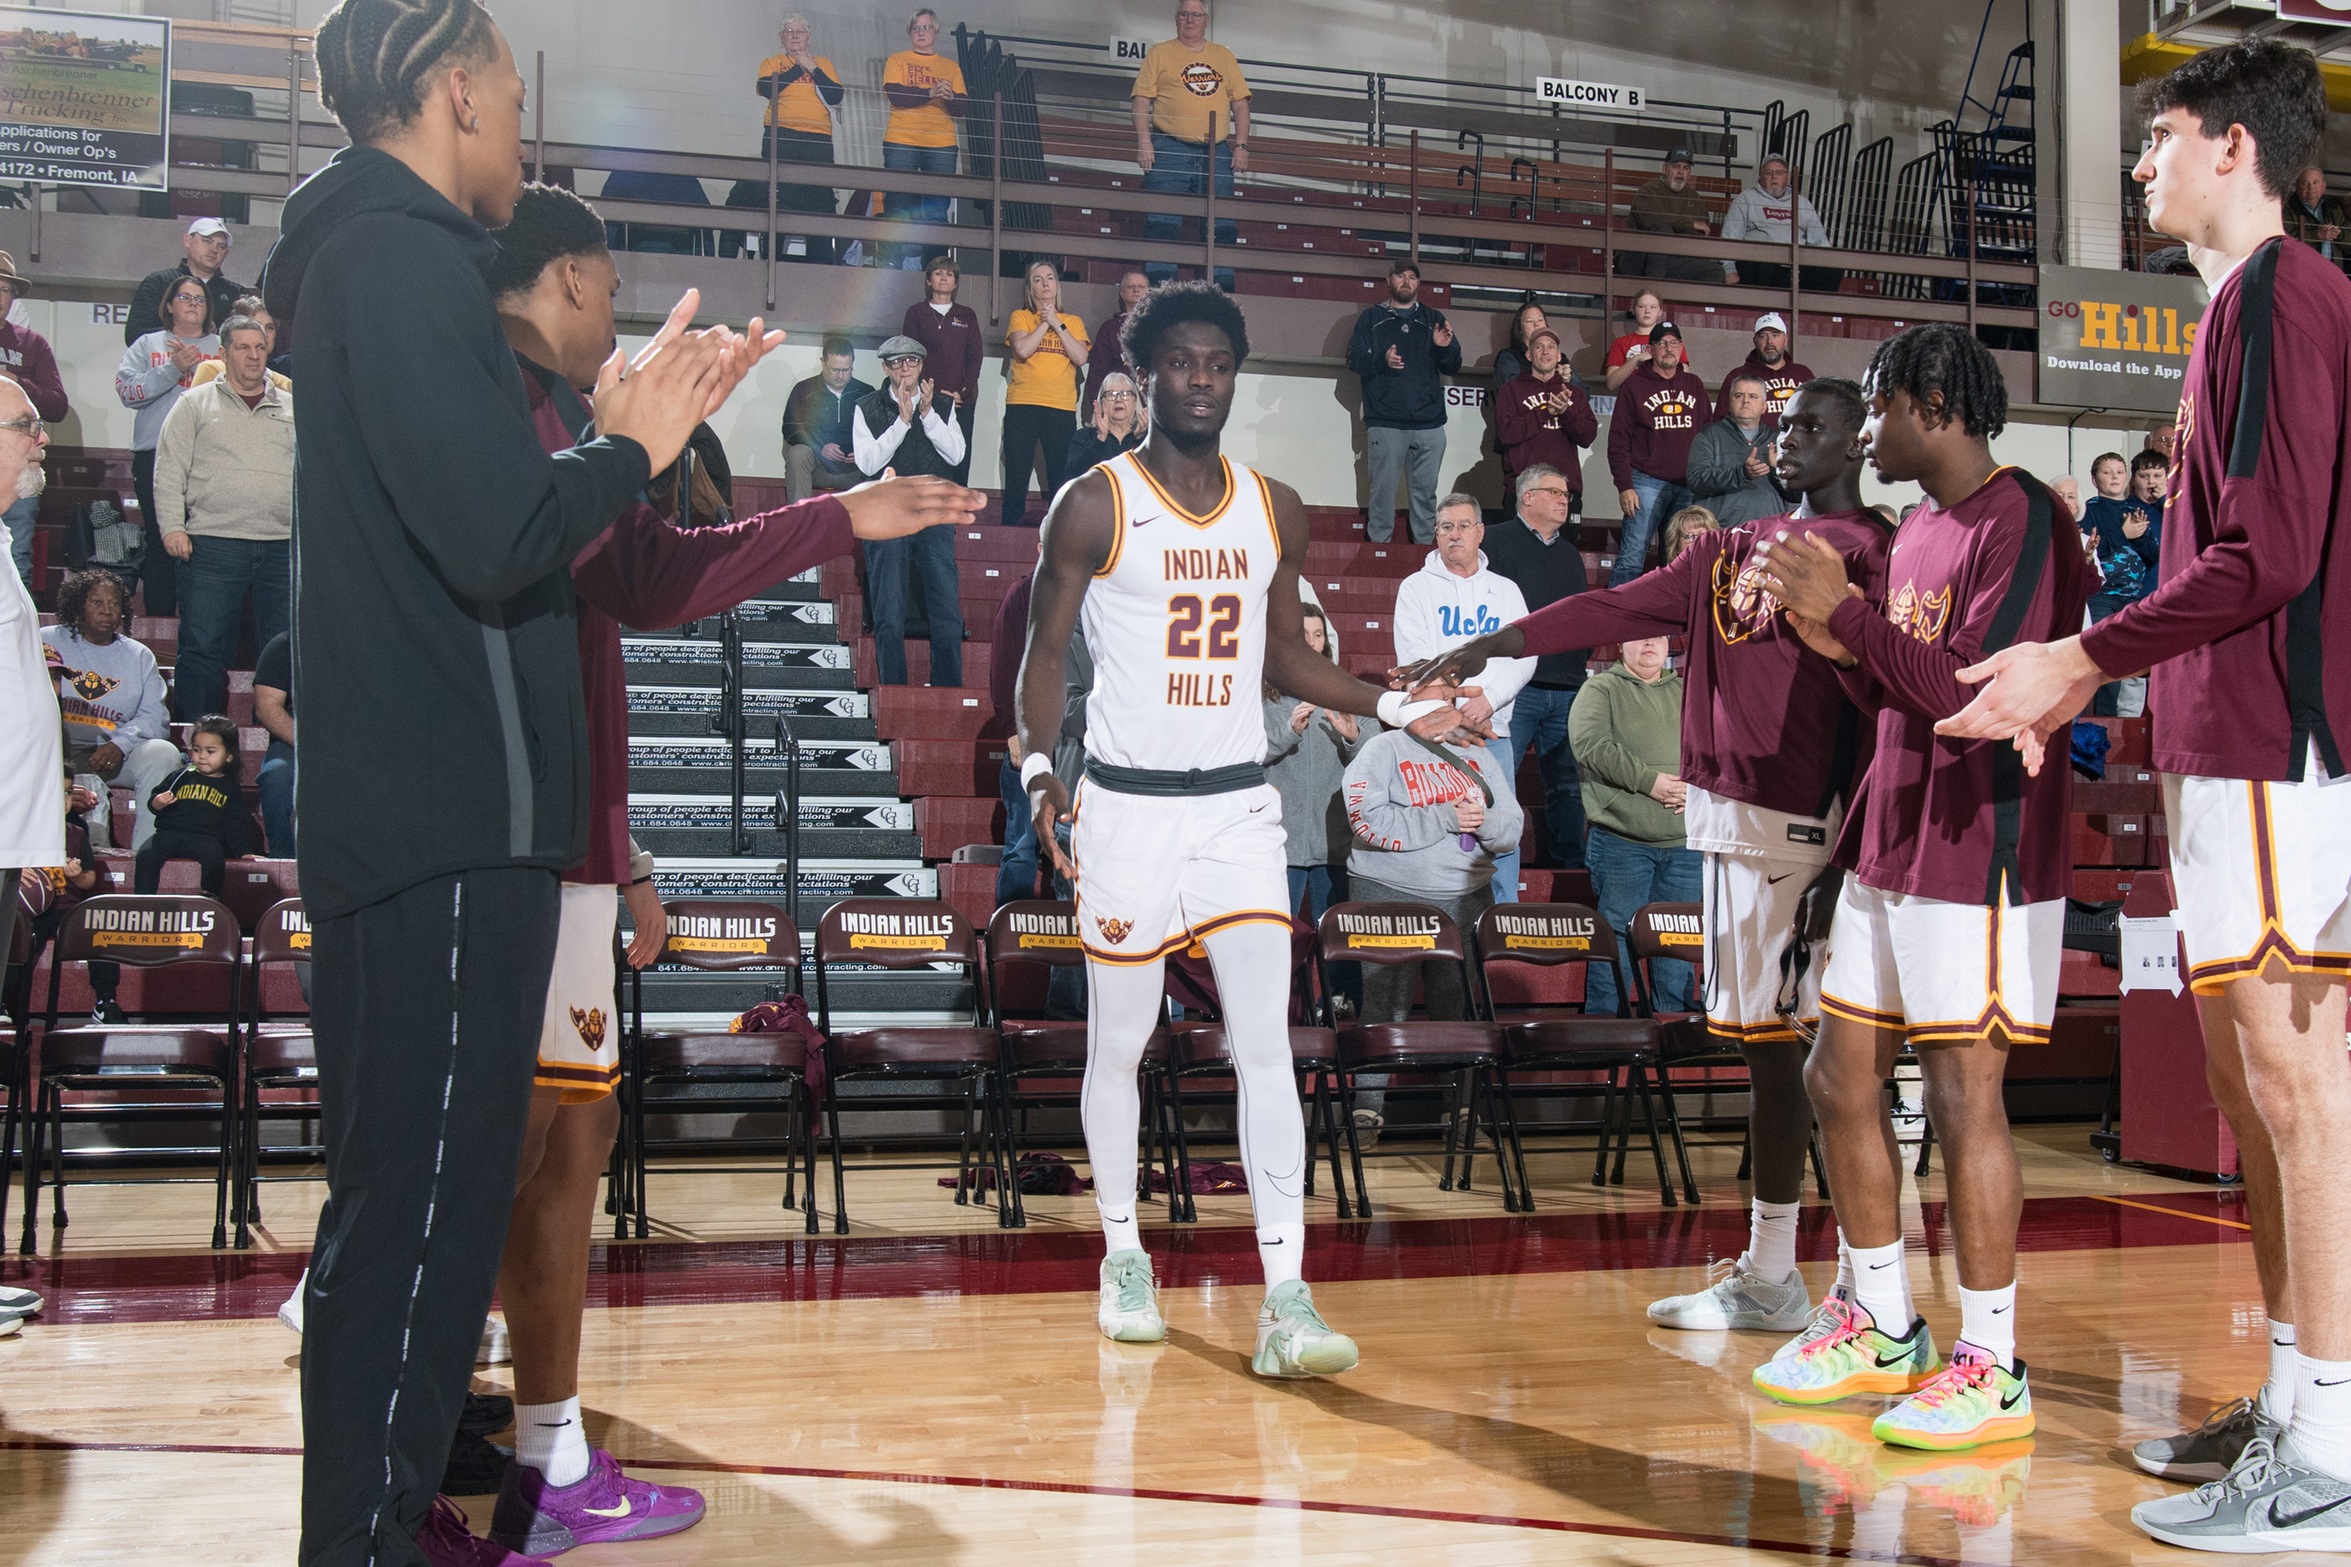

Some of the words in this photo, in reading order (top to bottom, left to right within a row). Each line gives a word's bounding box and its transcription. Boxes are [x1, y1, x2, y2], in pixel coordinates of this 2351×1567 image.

[12, 65, 98, 80] Aschenbrenner
[1544, 82, 1619, 104] BALCONY
[1629, 91, 1639, 105] B
[2, 99, 105, 124] Trucking
[0, 125, 78, 141] pplications
[82, 129, 102, 142] for
[33, 141, 80, 155] Owner
[84, 145, 117, 160] Op's
[48, 165, 117, 184] Fremont,
[122, 171, 138, 183] IA
[2048, 300, 2080, 318] GO
[2047, 356, 2121, 373] Download
[2126, 362, 2149, 375] the
[2154, 364, 2182, 380] App
[1654, 415, 1692, 430] HILLS
[1164, 548, 1248, 581] INDIAN
[1165, 592, 1243, 661] 22
[1166, 672, 1233, 706] HILLS
[704, 746, 756, 754] dediced
[660, 805, 672, 813] of
[1812, 832, 1821, 840] XL
[669, 873, 681, 881] of
[803, 873, 852, 881] fulfilling
[84, 909, 154, 931] INDIAN
[159, 910, 215, 932] HILLS
[726, 918, 776, 938] HILLS
[840, 912, 900, 935] INDIAN
[904, 915, 953, 935] HILLS
[1010, 913, 1067, 935] INDIAN
[1338, 914, 1396, 934] INDIAN
[1399, 915, 1441, 935] HILLS
[1495, 915, 1548, 935] INDIAN
[1552, 917, 1595, 937] HILLS
[1648, 913, 1700, 933] INDIAN
[104, 934, 195, 942] WARRIORS
[676, 940, 759, 949] WARRIORS
[858, 937, 938, 946] WARRIORS
[1354, 937, 1428, 945] WARRIORS
[1512, 937, 1583, 946] WARRIORS
